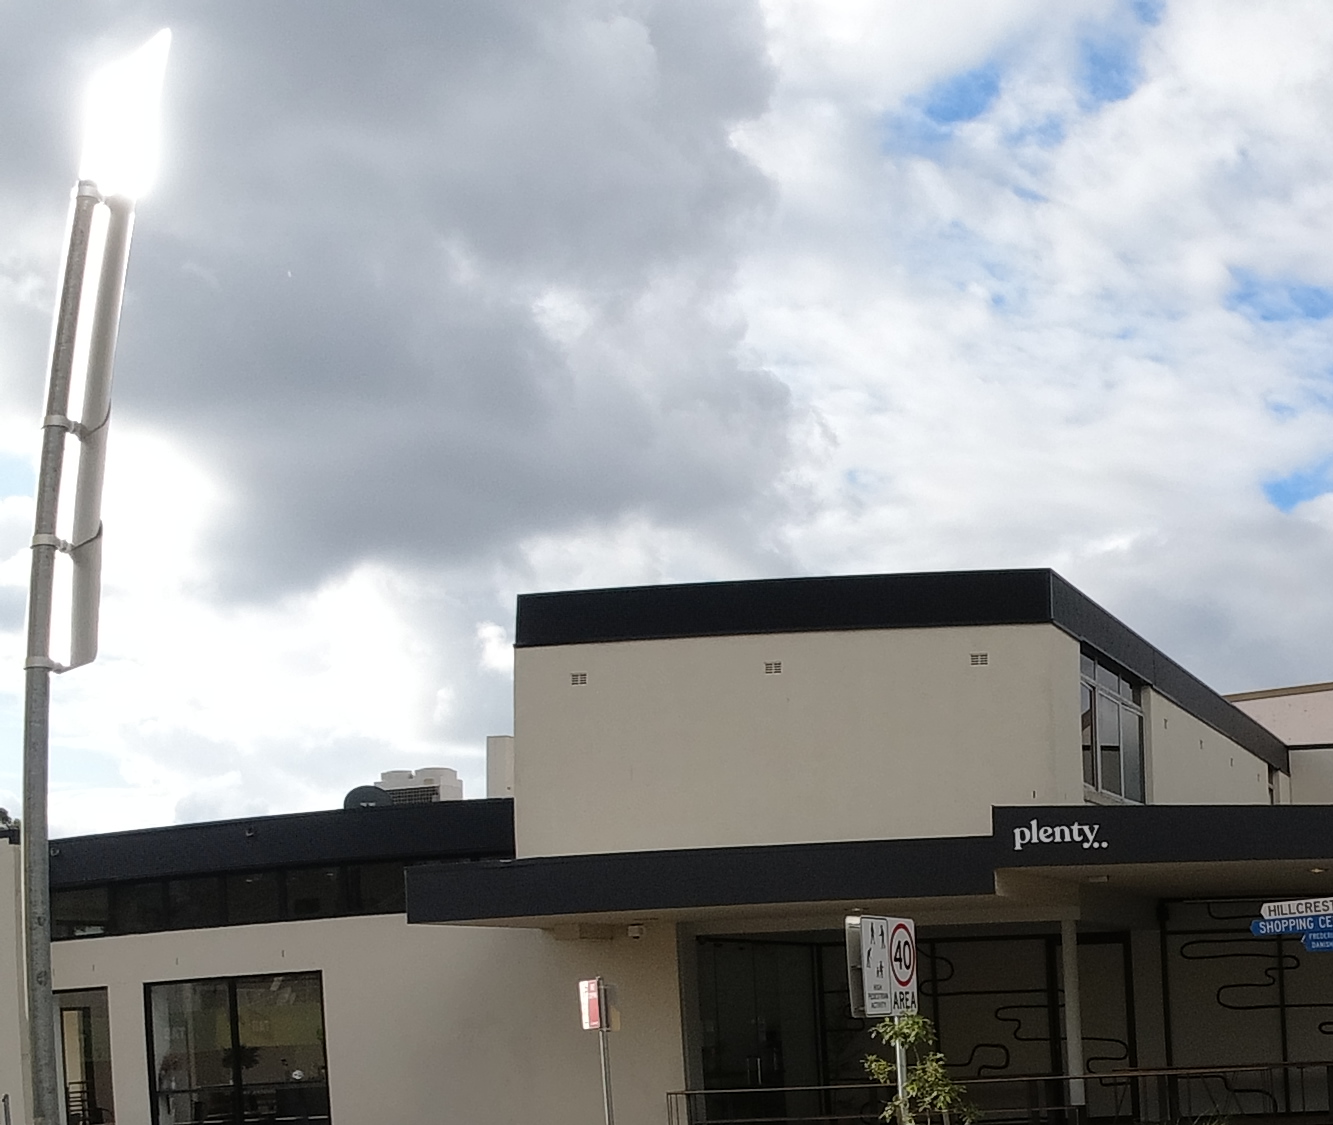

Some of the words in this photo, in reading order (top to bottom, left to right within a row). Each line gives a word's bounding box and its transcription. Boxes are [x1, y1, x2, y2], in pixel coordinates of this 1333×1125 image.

[1259, 917, 1314, 934] SHOPPING
[1311, 941, 1333, 949] DANISH
[893, 940, 912, 971] 40
[893, 991, 917, 1010] AREA
